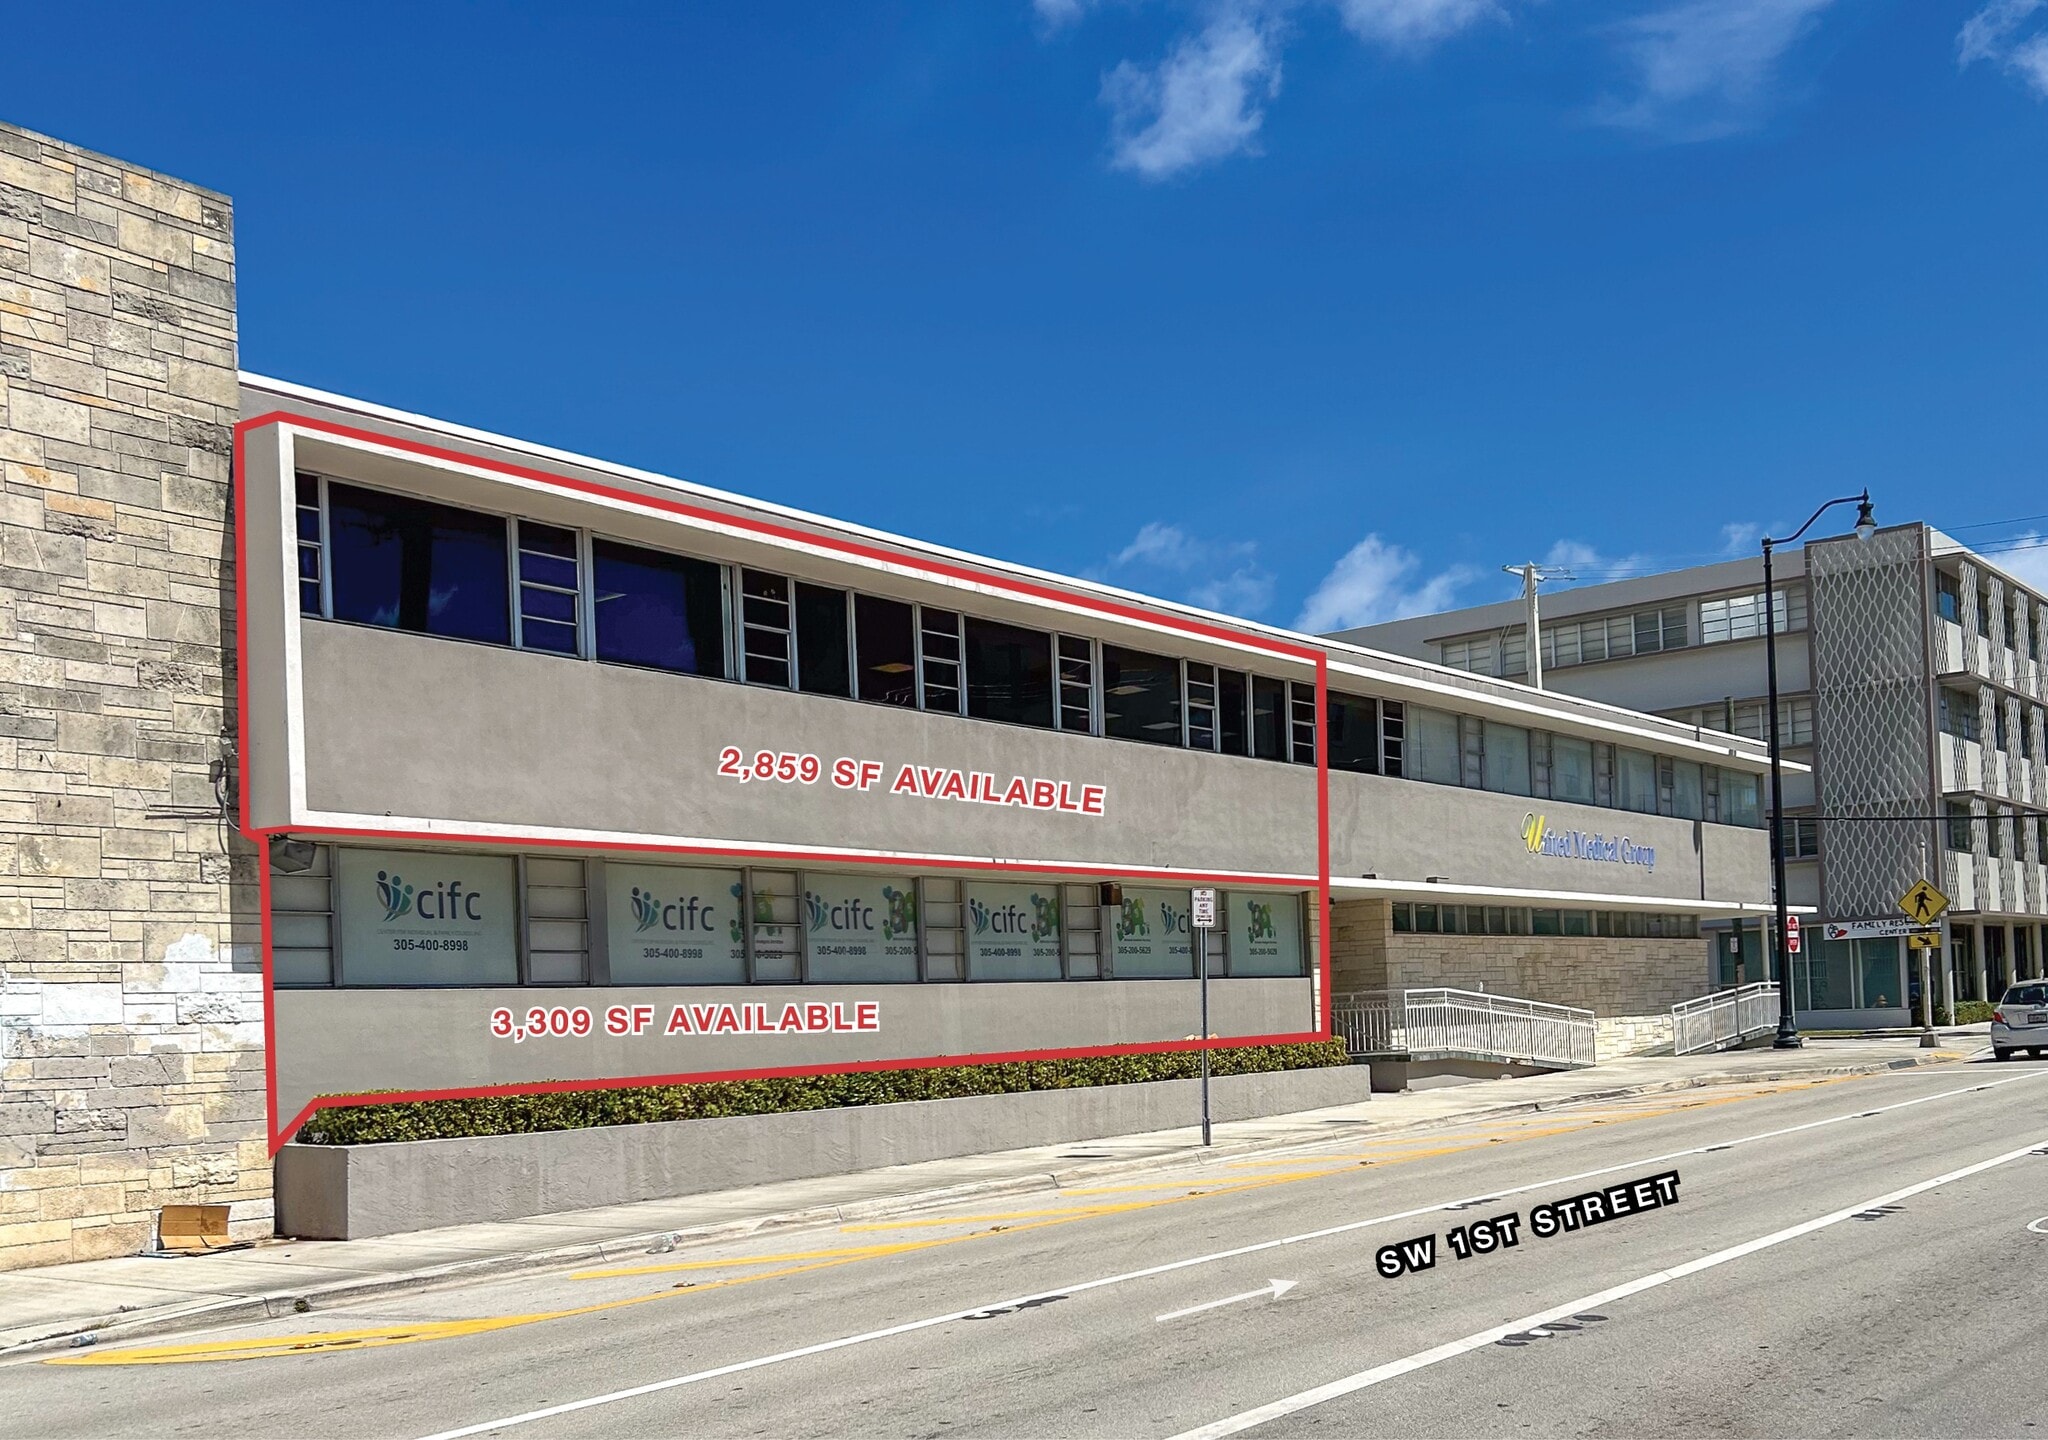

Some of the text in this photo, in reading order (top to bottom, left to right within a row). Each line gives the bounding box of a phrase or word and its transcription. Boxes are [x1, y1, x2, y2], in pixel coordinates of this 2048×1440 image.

[1573, 830, 1618, 862] Medical
[1621, 836, 1655, 873] Group
[417, 881, 482, 920] cifc
[663, 896, 714, 931] cifc
[831, 898, 874, 930] cifc
[991, 904, 1027, 933] cifc
[1851, 920, 1887, 930] FAMILY
[1879, 928, 1907, 936] CENTER
[393, 938, 469, 952] 305-400-8998
[643, 948, 703, 959] 305-400-8998
[816, 945, 867, 956] 305-400-8998
